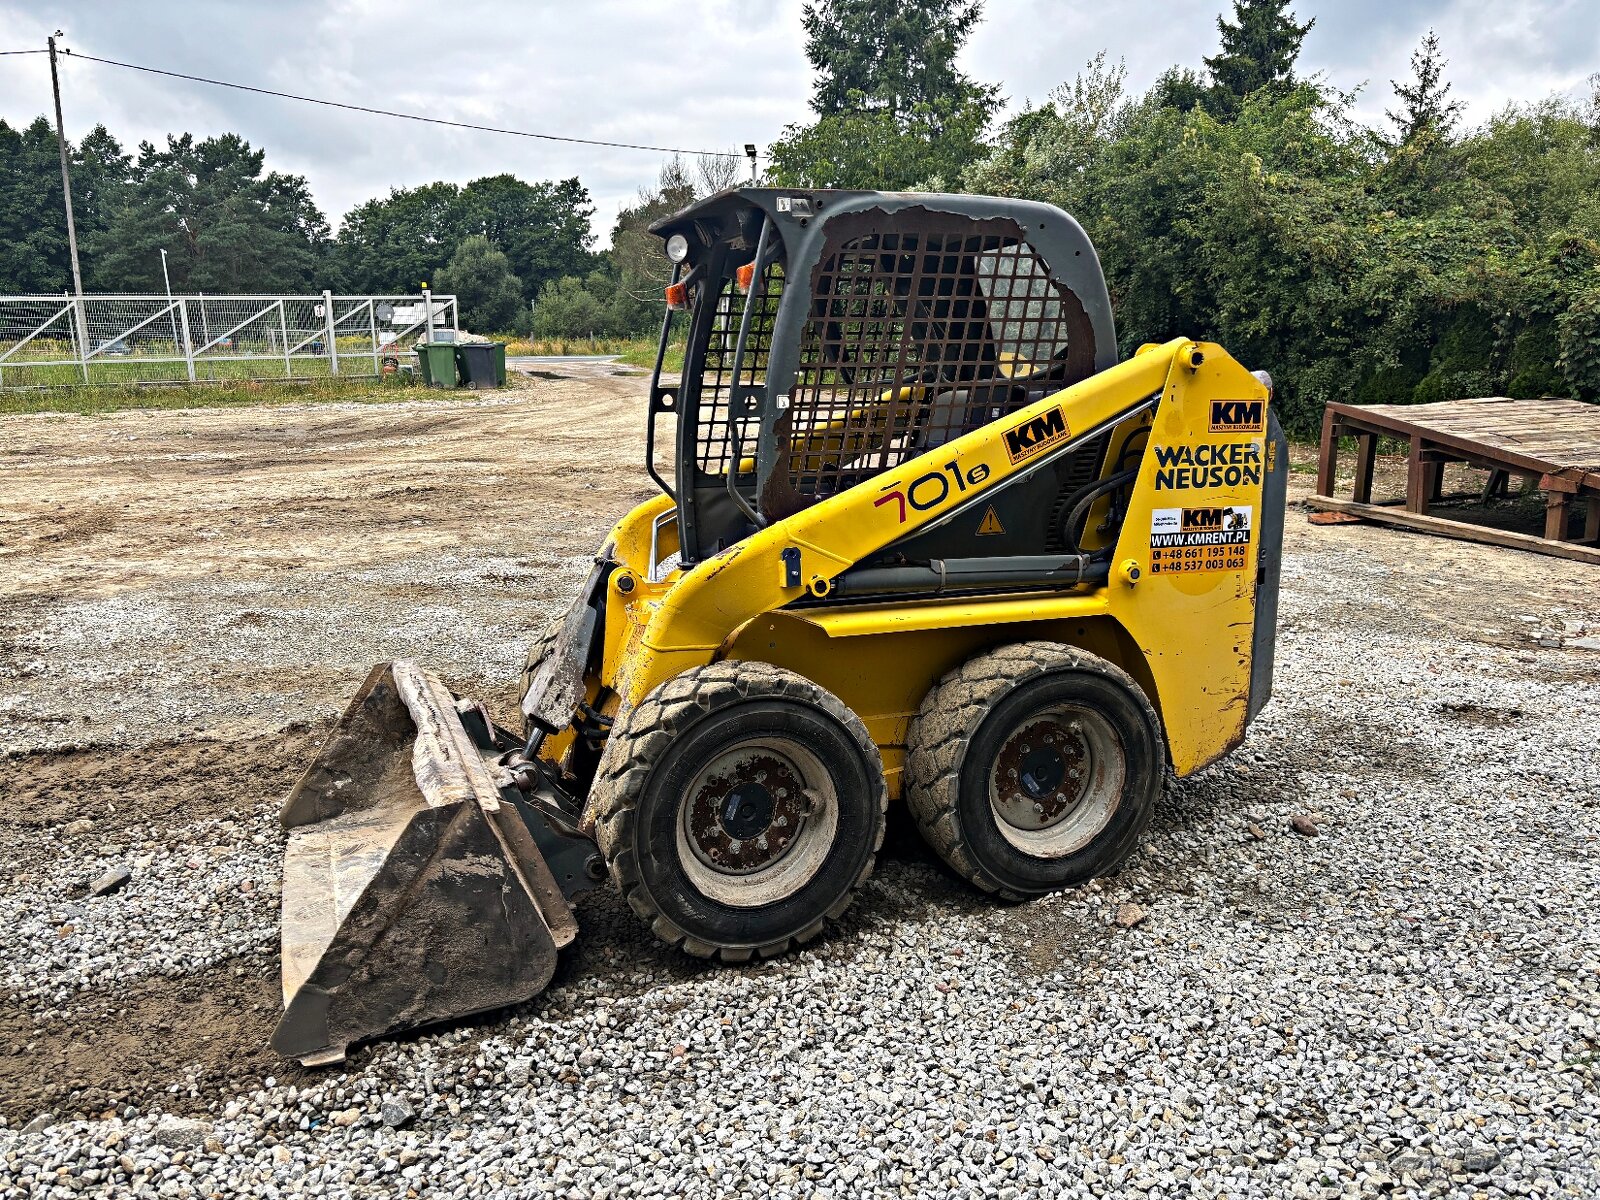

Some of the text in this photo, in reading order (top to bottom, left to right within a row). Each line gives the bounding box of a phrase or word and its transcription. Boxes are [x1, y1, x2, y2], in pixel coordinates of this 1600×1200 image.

[1212, 402, 1262, 425] KM
[1005, 408, 1066, 455] KM
[1154, 443, 1261, 468] WACKER
[1155, 465, 1260, 490] NEUSON
[1183, 509, 1222, 527] KM
[1152, 531, 1249, 547] WWW.KMRENT.PL
[1163, 546, 1245, 559] +48 661 195 148
[1163, 558, 1244, 571] +48 537 003 063
